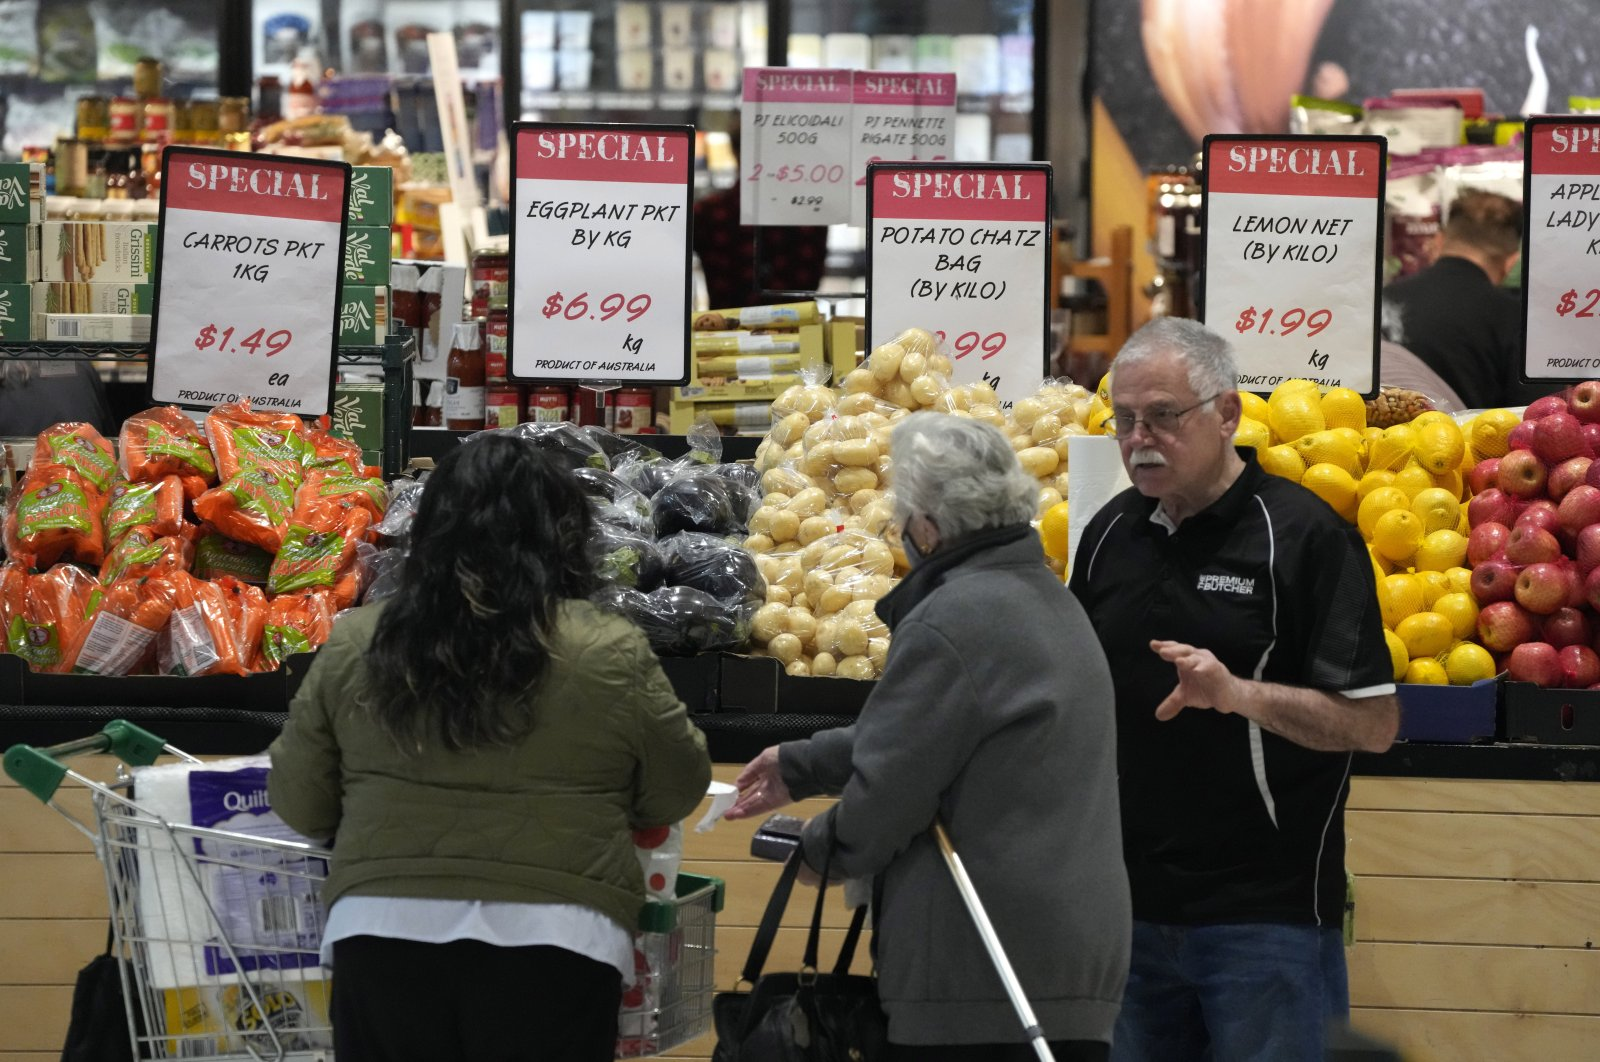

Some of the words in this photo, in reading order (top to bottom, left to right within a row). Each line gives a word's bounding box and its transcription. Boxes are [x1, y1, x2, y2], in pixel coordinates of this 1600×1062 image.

[756, 74, 840, 92] SPECIAL
[865, 77, 947, 96] SPECIAL
[772, 114, 844, 127] ELICOIDALI
[883, 116, 946, 129] PENNETTE
[537, 131, 674, 162] SPECIAL
[776, 131, 818, 144] 500G
[861, 132, 906, 145] RIGATE
[909, 132, 947, 146] 500G
[1228, 145, 1365, 176] SPECIAL
[187, 162, 328, 200] SPECIAL
[892, 171, 1031, 200] SPECIAL
[526, 201, 638, 221] EGGPLANT
[641, 204, 680, 222] PKT
[1546, 210, 1600, 231] LADY
[1232, 215, 1308, 234] LEMON
[1311, 218, 1353, 236] NET
[183, 232, 279, 256] CARROTS
[284, 240, 325, 259] PKT
[571, 229, 601, 250] BY
[603, 230, 632, 248] KG
[880, 226, 965, 245] POTATO
[970, 228, 1041, 247] CHATZ
[1586, 238, 1600, 255] K
[130, 229, 143, 277] Grissini
[1243, 240, 1280, 264] (BY
[1282, 244, 1338, 264] KILO)
[232, 263, 269, 283] 1KG
[935, 254, 982, 273] BAG
[911, 279, 947, 301] (BY
[950, 281, 1006, 300] KILO)
[541, 291, 652, 323] $6.99
[1235, 306, 1333, 338] $1.99
[194, 323, 293, 357] $1.49
[622, 333, 644, 355] kg
[535, 360, 582, 370] PRODUCT
[582, 361, 597, 370] OF
[598, 361, 656, 372] AUSTRALIA
[1308, 349, 1330, 371] kg
[1547, 358, 1591, 368] PRODUCT
[268, 372, 290, 386] ea
[1268, 376, 1283, 385] OF
[178, 389, 223, 402] PRODUCT
[247, 394, 302, 407] USTRALIA
[1203, 582, 1254, 595] BUTCHER
[1205, 575, 1255, 587] PREMIUM
[223, 789, 271, 812] Quilt
